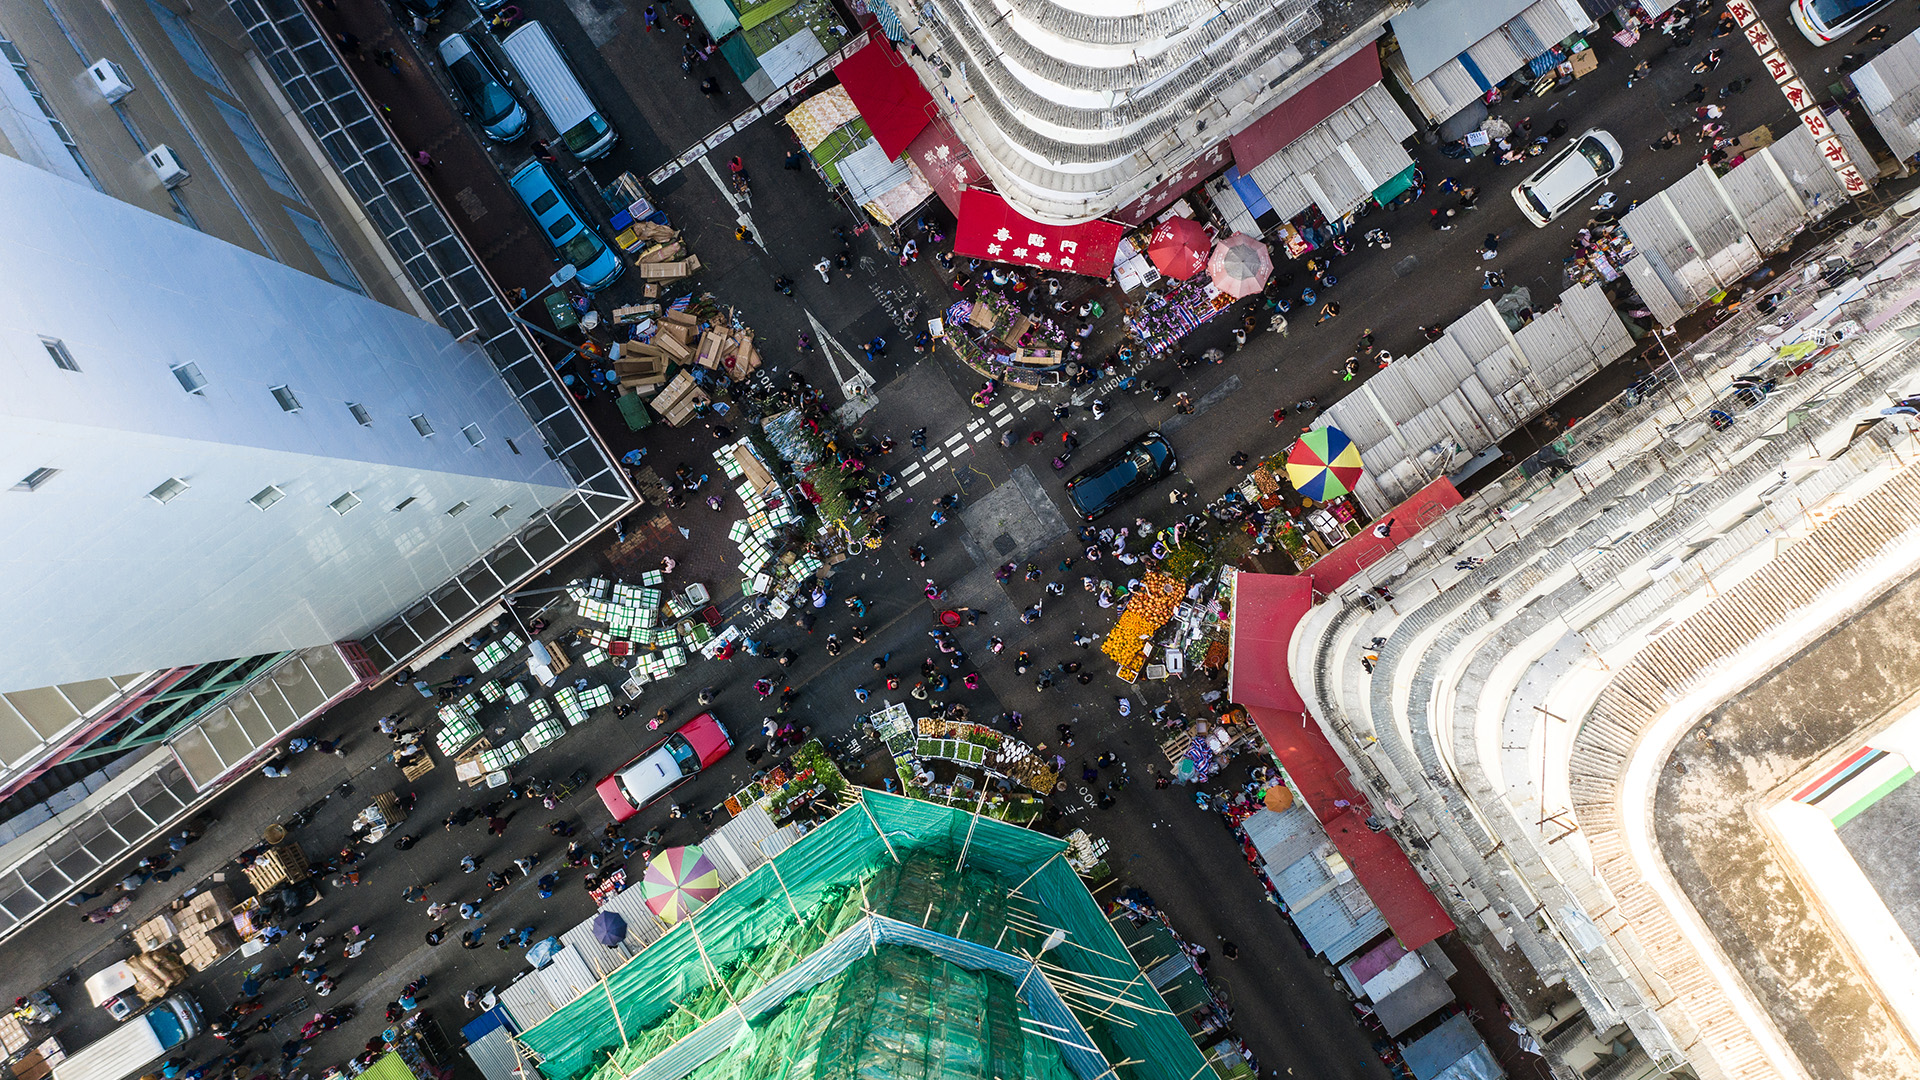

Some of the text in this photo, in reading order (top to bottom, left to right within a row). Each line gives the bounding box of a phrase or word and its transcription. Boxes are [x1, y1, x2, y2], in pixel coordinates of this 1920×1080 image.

[993, 227, 1078, 254] 喜臨門
[755, 369, 776, 393] OOK
